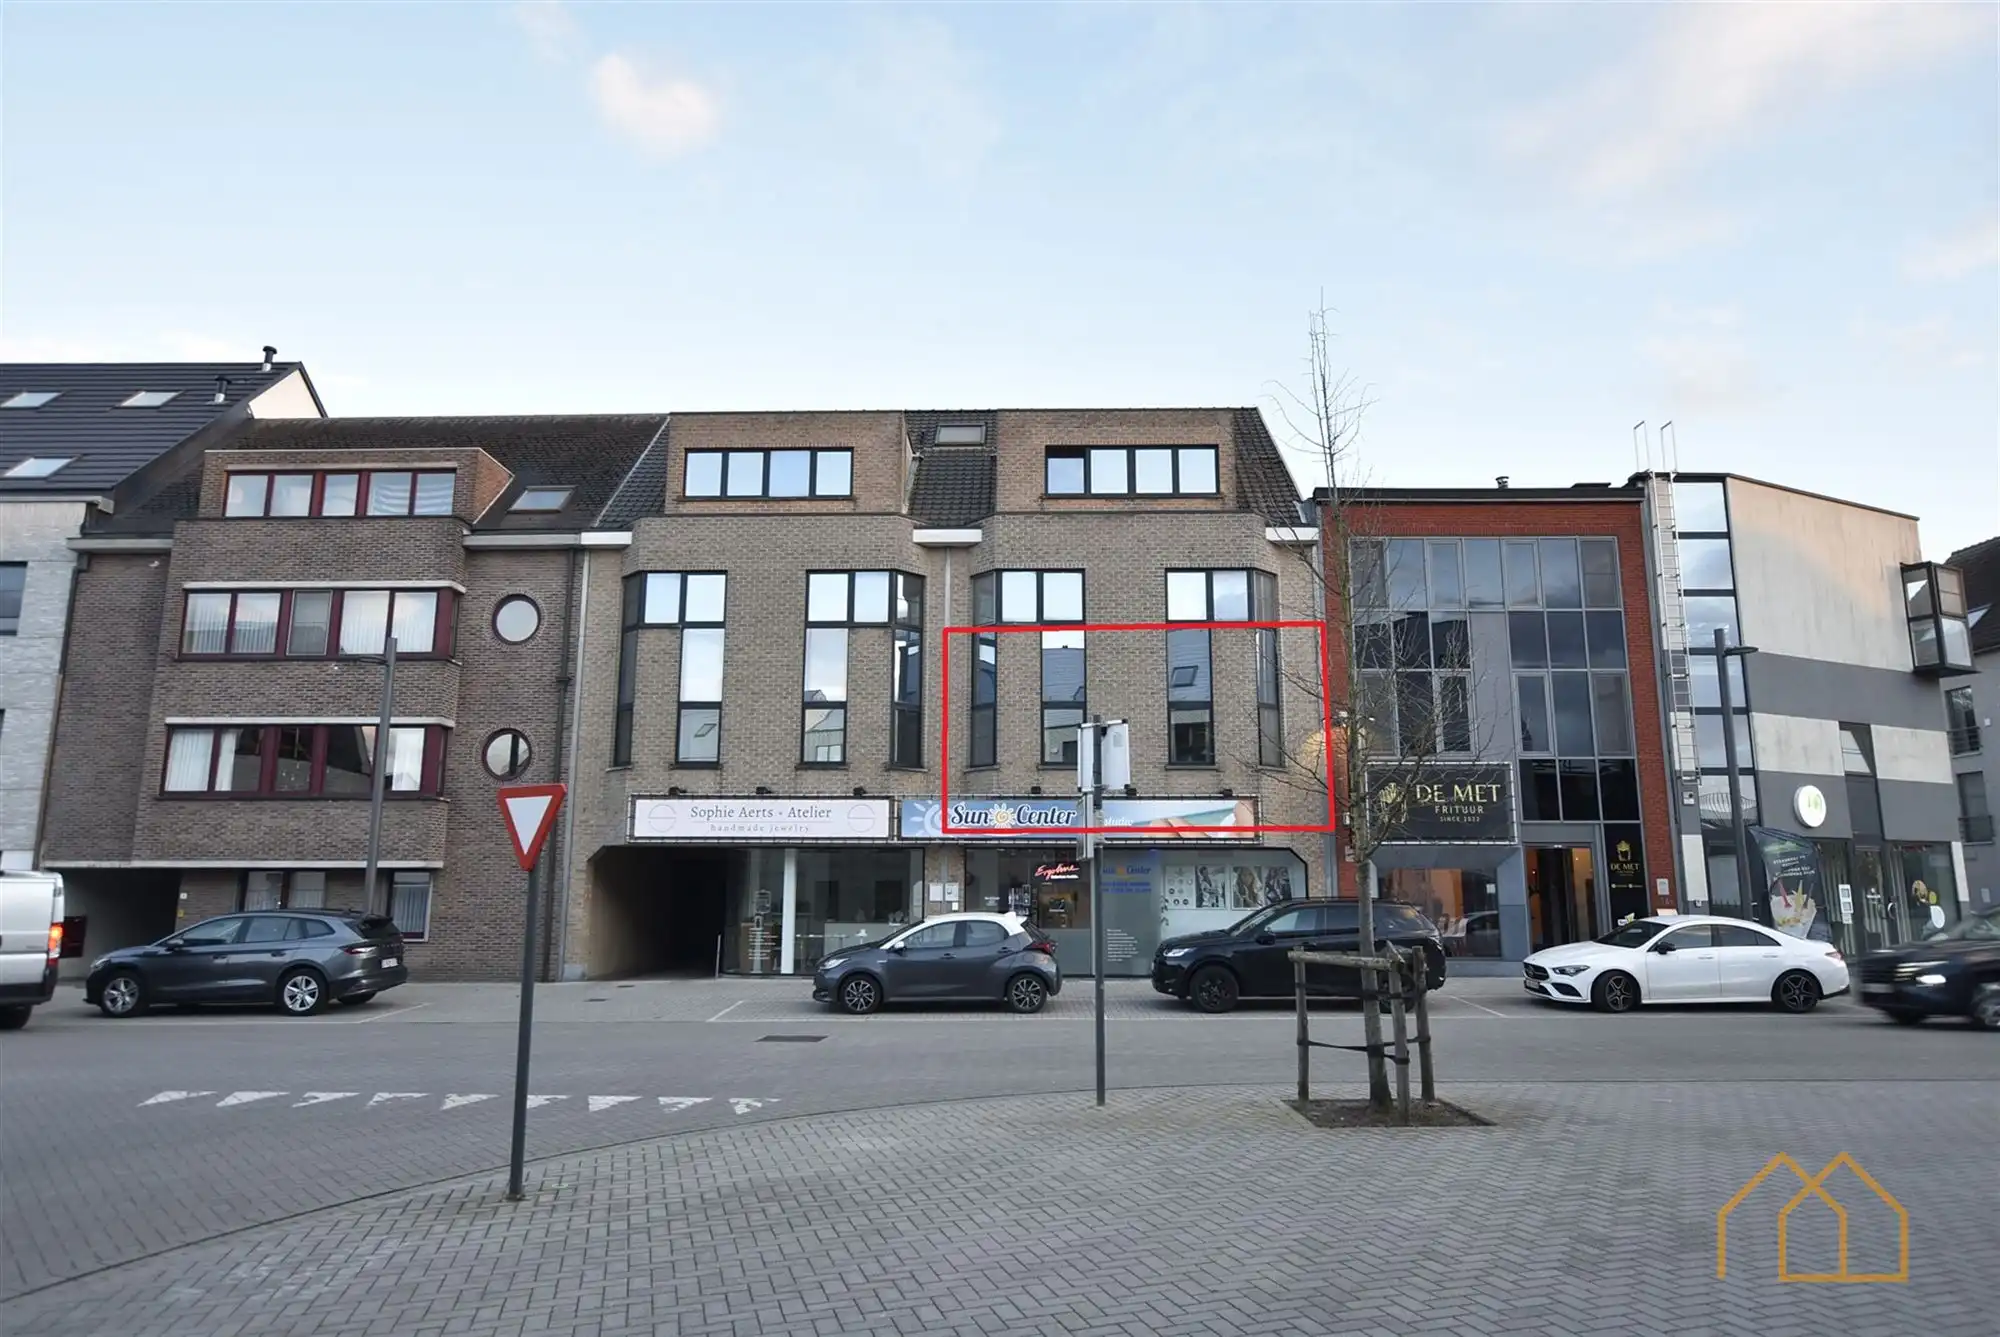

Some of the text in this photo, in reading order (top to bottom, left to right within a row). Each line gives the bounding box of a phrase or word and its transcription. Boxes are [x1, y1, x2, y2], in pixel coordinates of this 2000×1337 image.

[1416, 784, 1501, 803] DE MET
[690, 805, 832, 821] Sophie Aerts Atelier
[951, 803, 1077, 826] Sun Center
[1434, 805, 1484, 814] FRITUUR
[710, 824, 809, 833] handmade jewelry
[1623, 863, 1640, 871] MET
